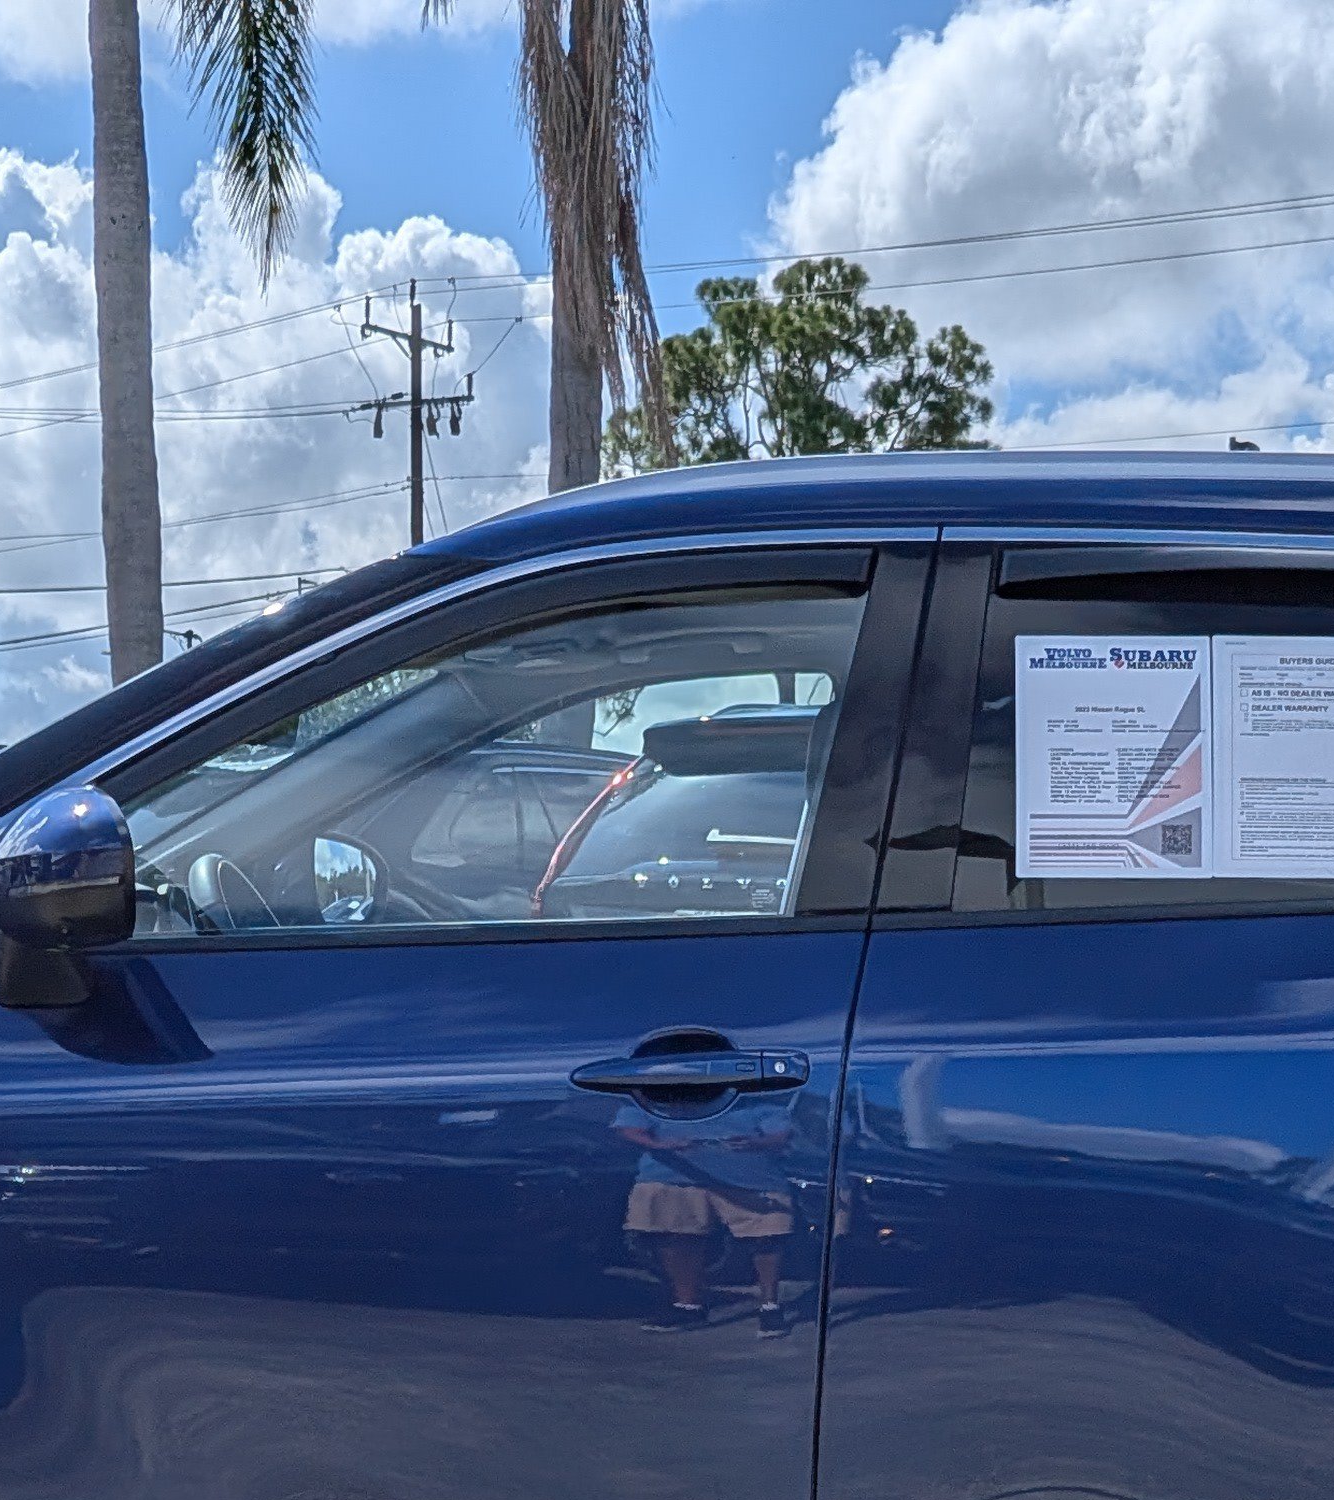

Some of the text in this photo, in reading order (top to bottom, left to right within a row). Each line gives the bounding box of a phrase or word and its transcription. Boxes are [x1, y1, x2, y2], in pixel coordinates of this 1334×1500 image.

[1044, 648, 1093, 660] VOLVO
[1109, 647, 1198, 662] SUBARU
[1029, 658, 1108, 669] MELBOURNE
[1126, 661, 1194, 670] MELBOURNE
[1279, 657, 1314, 665] BUYERS
[1290, 690, 1324, 698] DEALER
[1251, 704, 1329, 713] DEALER WARRANTY
